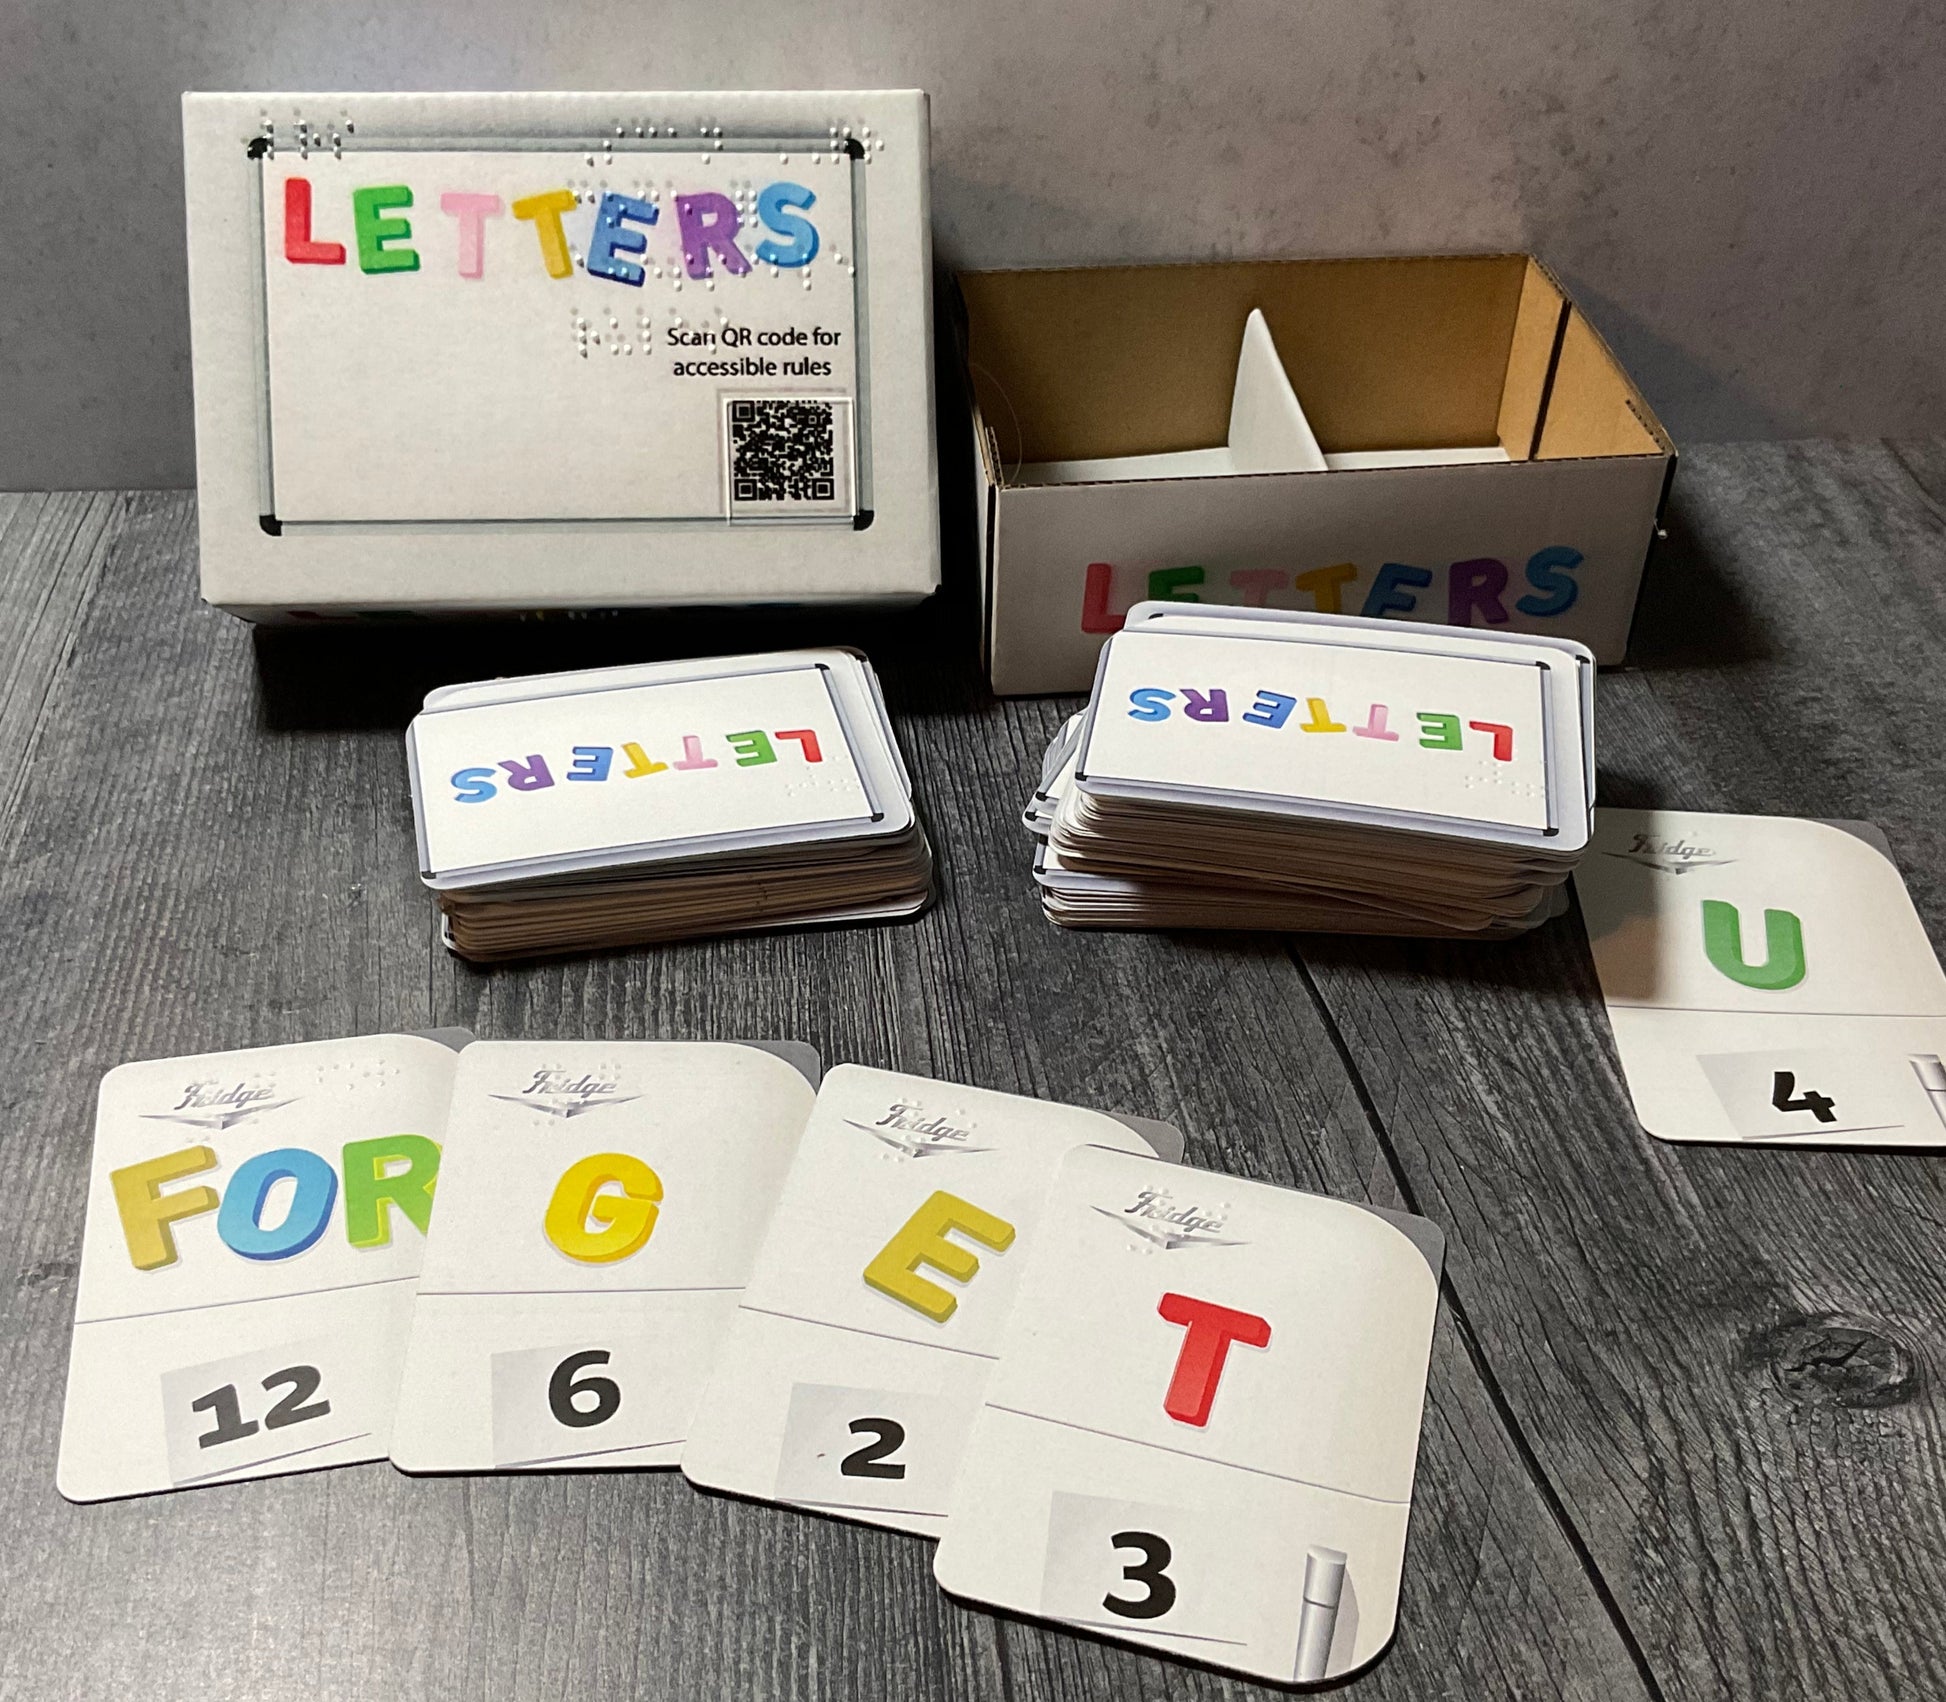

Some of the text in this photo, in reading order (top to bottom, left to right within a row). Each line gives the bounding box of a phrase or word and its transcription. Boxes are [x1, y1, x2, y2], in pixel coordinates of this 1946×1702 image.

[284, 177, 819, 287] LETTERS
[667, 326, 841, 348] Scan QR code for
[673, 356, 832, 377] accessible rules
[1127, 687, 1514, 762] LETTERS
[450, 728, 823, 804] LETTERS
[1701, 899, 1807, 991] U
[522, 1069, 617, 1099] Fridge
[876, 1103, 970, 1142] Fridge
[1772, 1071, 1837, 1123] 4
[109, 1134, 443, 1272] FOR
[544, 1152, 664, 1265] G
[1124, 1190, 1224, 1233] Fridge
[863, 1190, 1016, 1325] E
[548, 1350, 621, 1428] 6
[1157, 1292, 1272, 1428] T
[192, 1365, 331, 1449] 12
[840, 1417, 906, 1480] 2
[1102, 1532, 1177, 1619] 3
